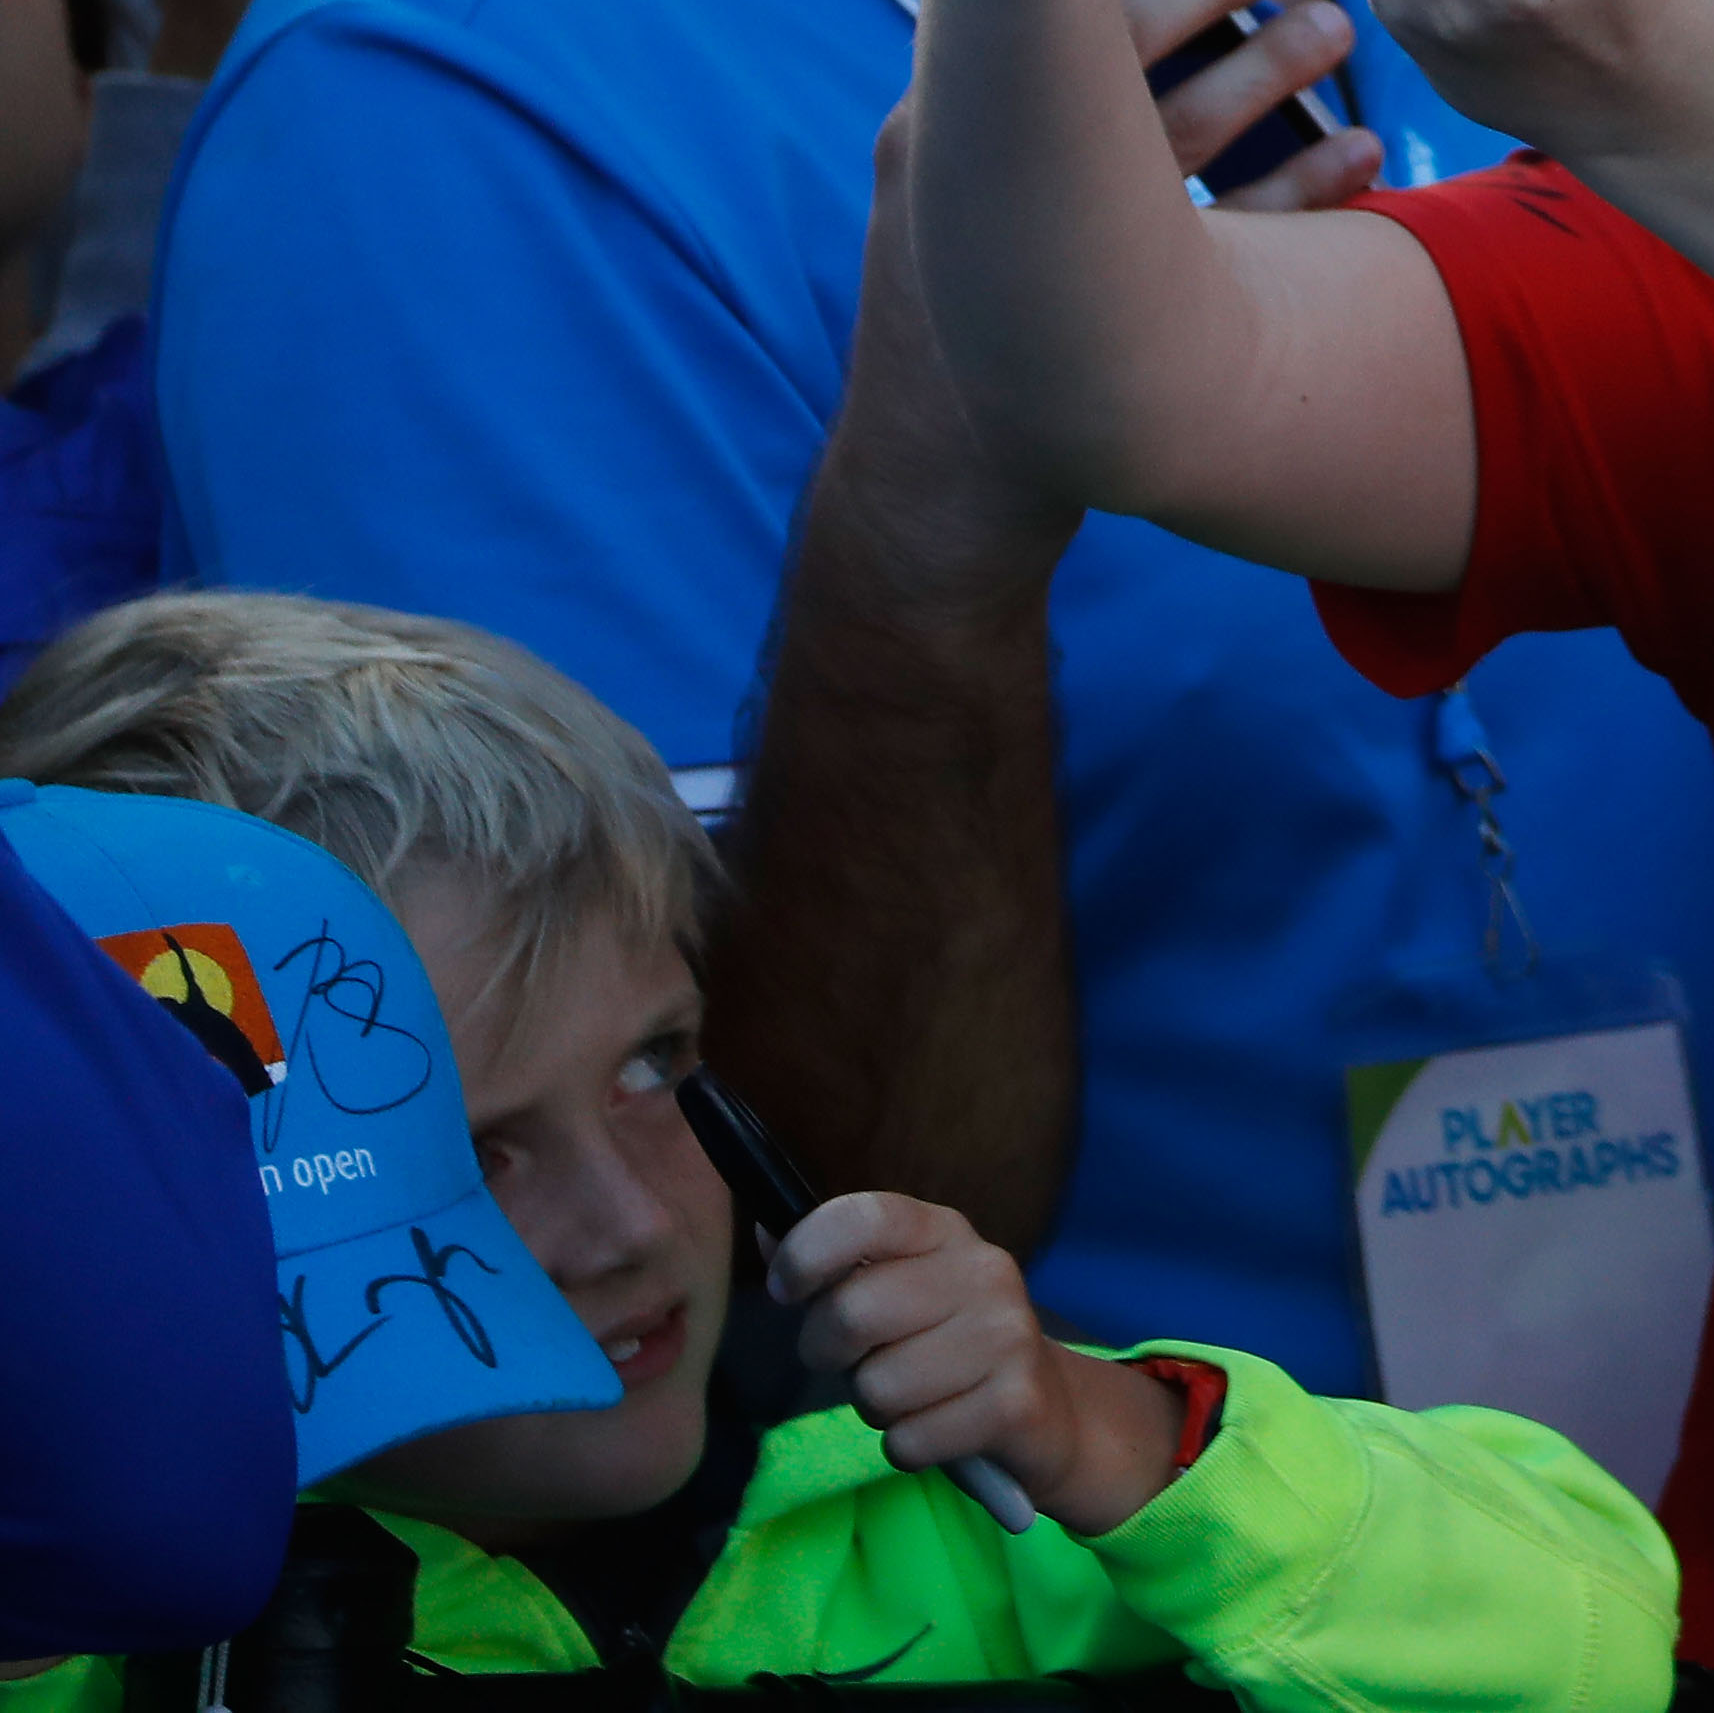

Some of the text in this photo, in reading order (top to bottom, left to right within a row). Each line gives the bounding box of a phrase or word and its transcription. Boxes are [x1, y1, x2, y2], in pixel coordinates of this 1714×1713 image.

[1441, 1091, 1600, 1153] PLAYER
[293, 1147, 377, 1195] open
[1381, 1132, 1681, 1217] AUTOGRAPHS
